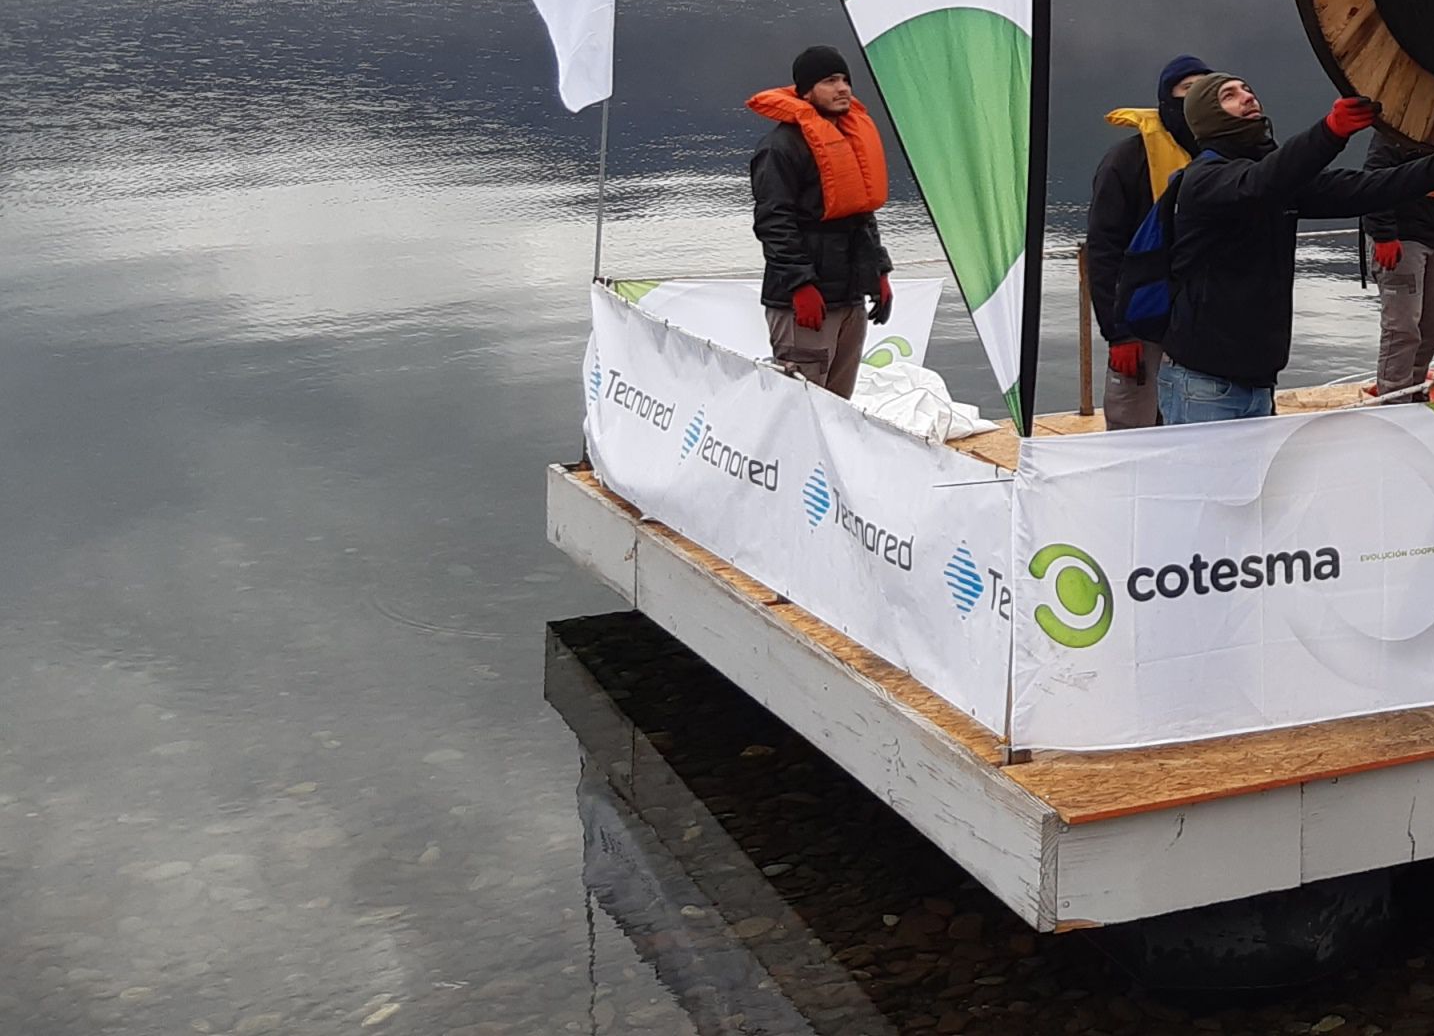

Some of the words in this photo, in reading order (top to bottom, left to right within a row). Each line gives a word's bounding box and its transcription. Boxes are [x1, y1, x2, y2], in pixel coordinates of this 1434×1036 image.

[605, 369, 676, 432] Tecnored
[697, 424, 779, 492] Tecnored
[833, 487, 915, 572] Tecnored
[1127, 546, 1340, 603] cotesma
[1360, 549, 1407, 562] EVOLUCIÓN
